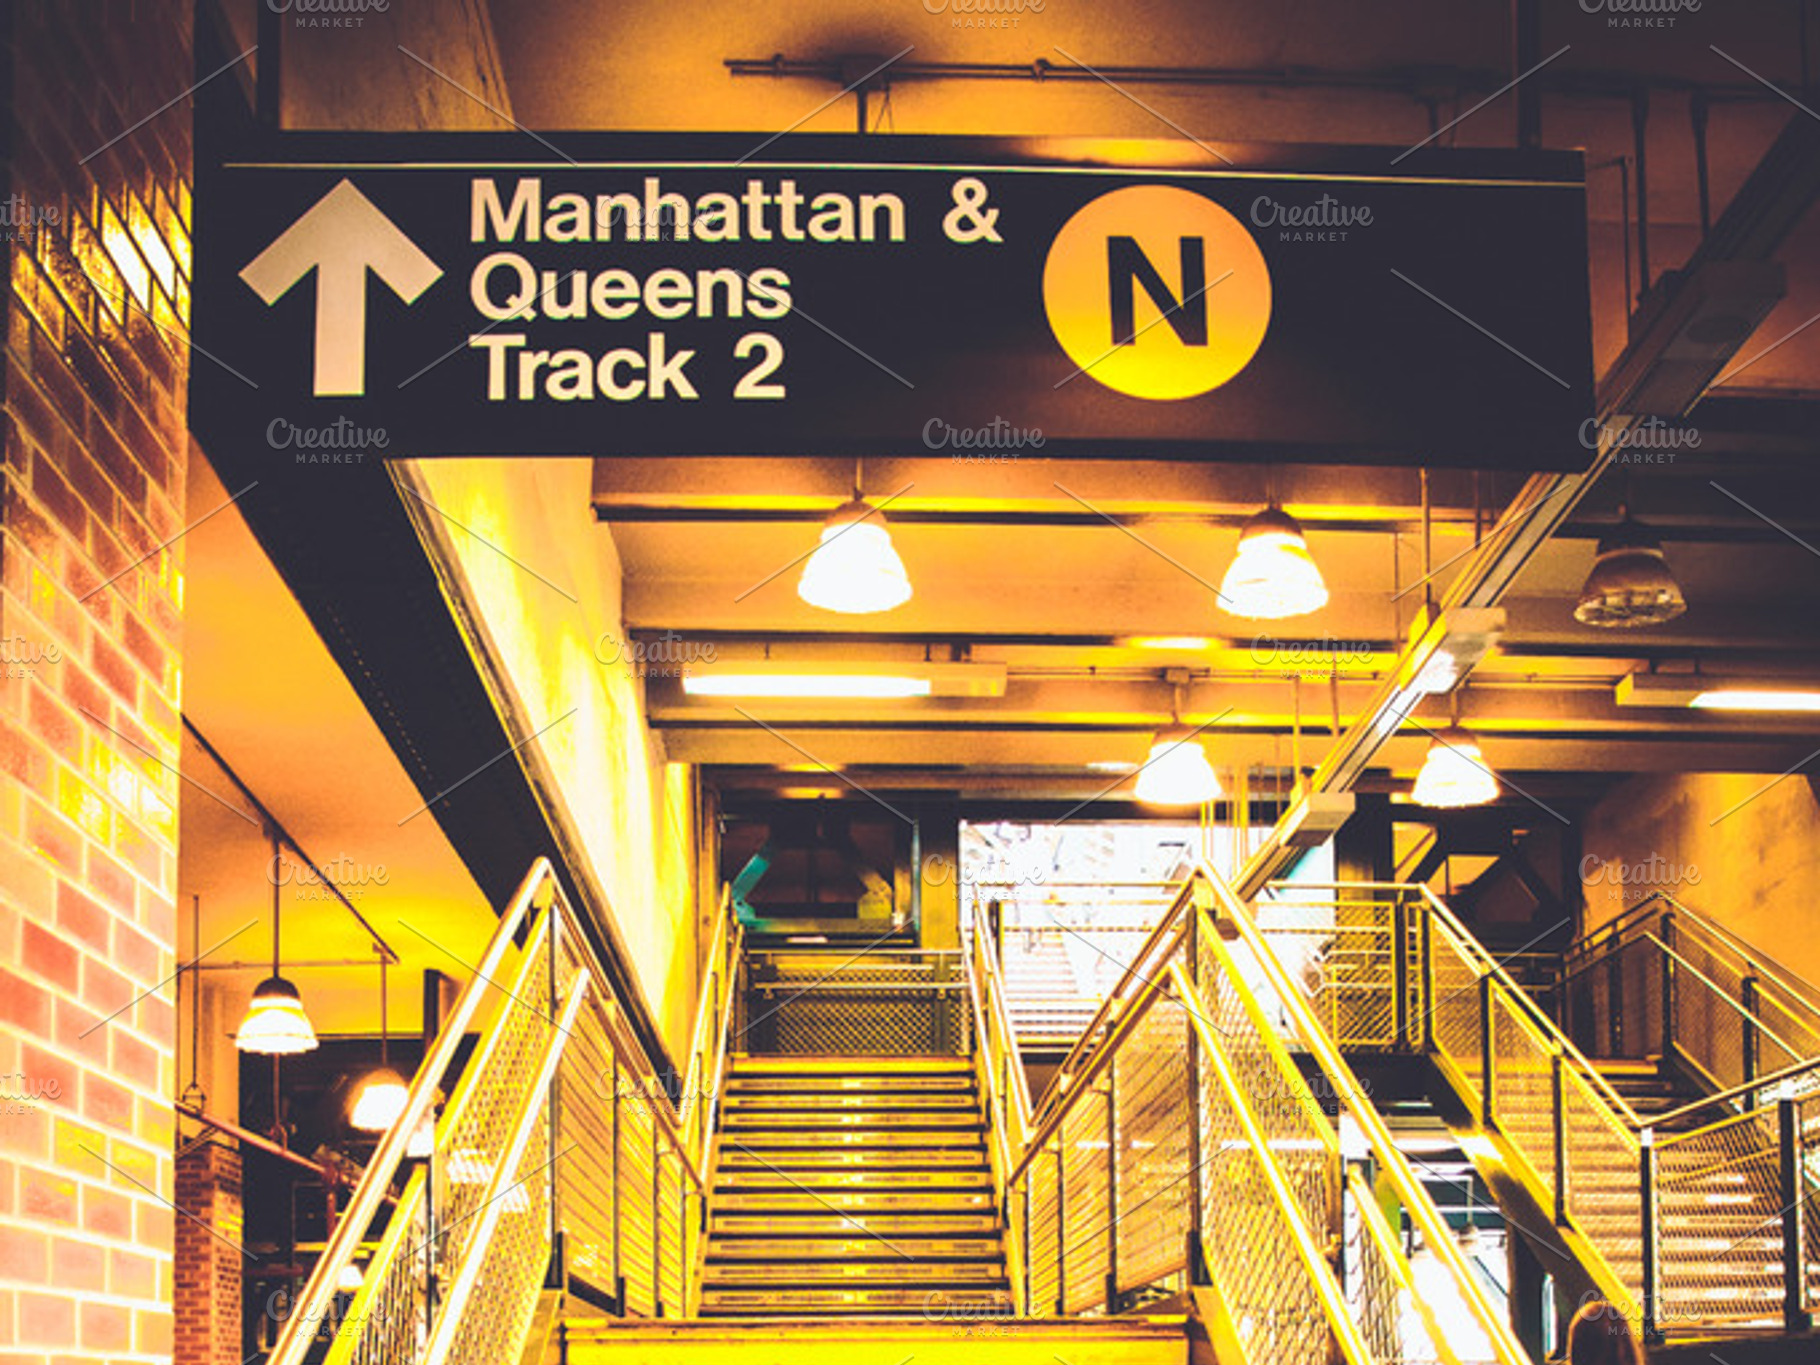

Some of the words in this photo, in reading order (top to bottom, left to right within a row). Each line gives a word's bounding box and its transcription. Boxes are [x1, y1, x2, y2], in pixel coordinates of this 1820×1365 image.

[470, 177, 905, 242] Manhattan
[942, 177, 1004, 243] &
[470, 252, 793, 321] Queens
[1106, 235, 1208, 347] N
[469, 333, 699, 399] Track
[734, 331, 786, 399] 2
